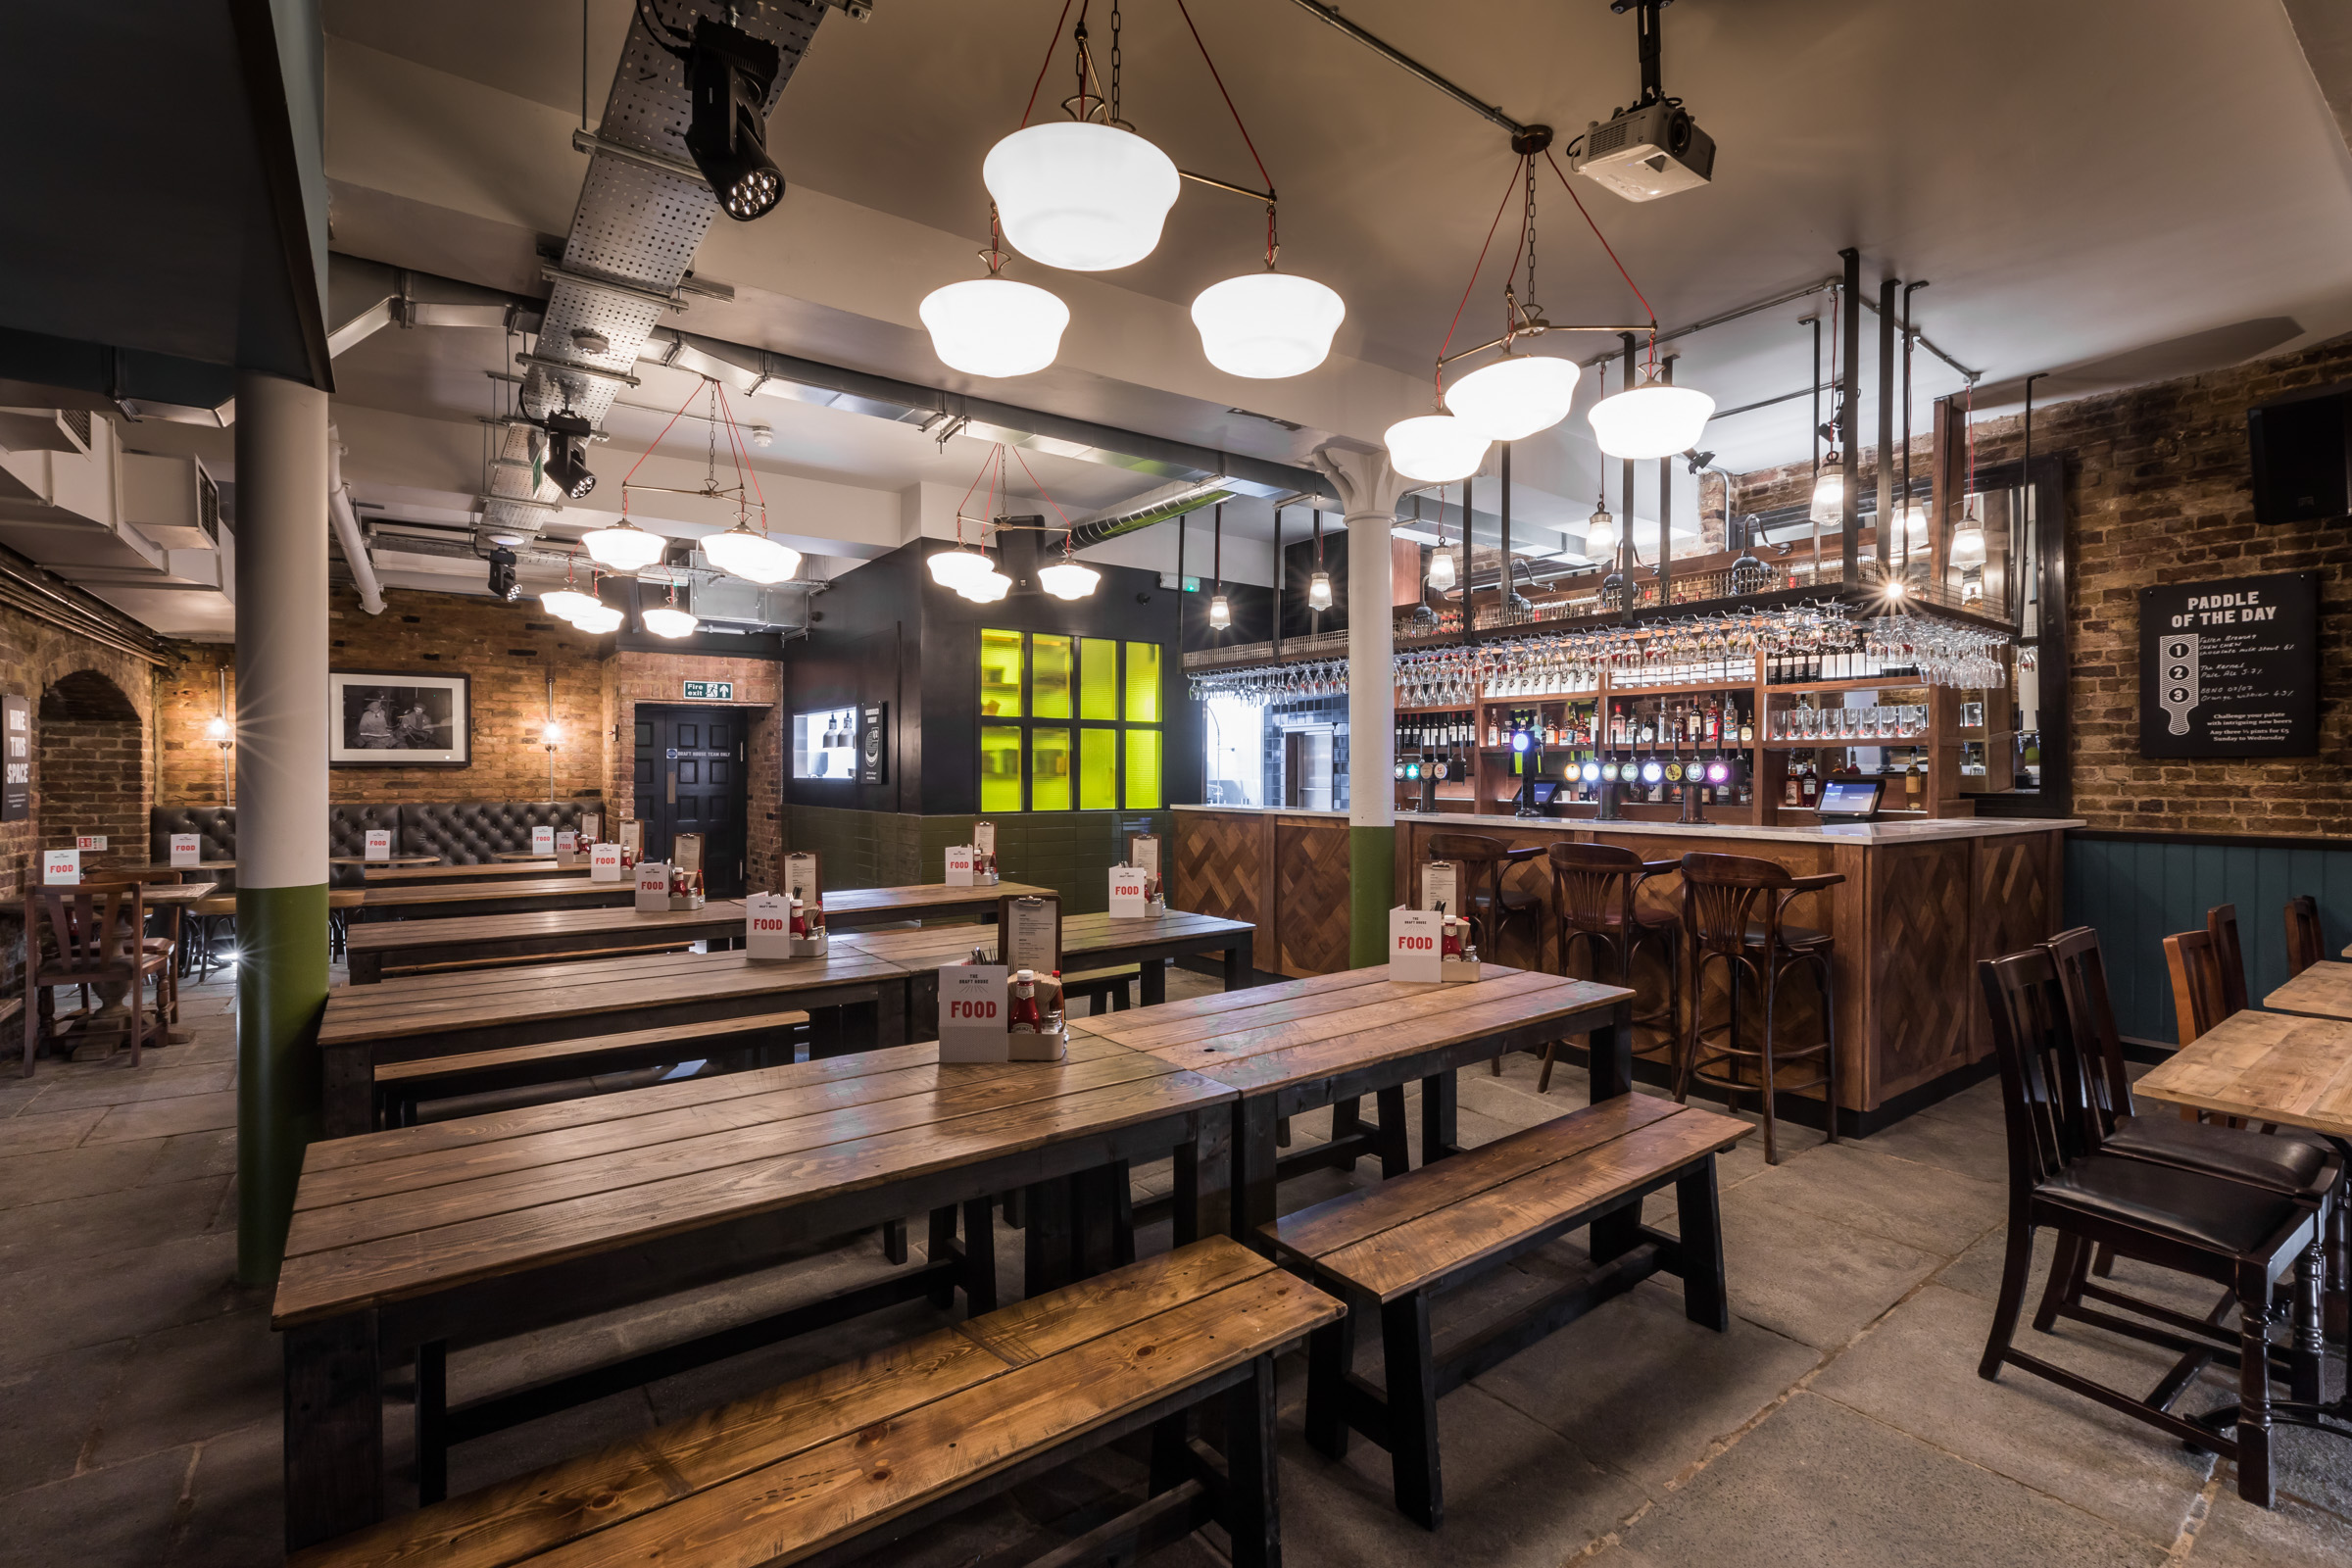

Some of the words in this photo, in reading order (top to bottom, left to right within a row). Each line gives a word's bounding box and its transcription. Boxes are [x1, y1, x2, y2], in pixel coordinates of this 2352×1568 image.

[2188, 591, 2259, 610] PADDLE
[2172, 614, 2194, 627] OF
[2199, 610, 2236, 625] THE
[2242, 606, 2277, 622] DAY
[2175, 646, 2182, 656] 1
[2174, 668, 2183, 678] 2
[2174, 690, 2183, 701] 3
[10, 710, 26, 730] HIRE
[10, 737, 26, 757] THIS
[7, 763, 29, 784] SPACE
[50, 865, 73, 873] FOOD
[641, 882, 663, 890] FOOD
[1115, 886, 1139, 895] FOOD
[754, 919, 783, 930] FOOD
[1398, 937, 1433, 950] FOOD
[951, 1001, 996, 1018] FOOD
